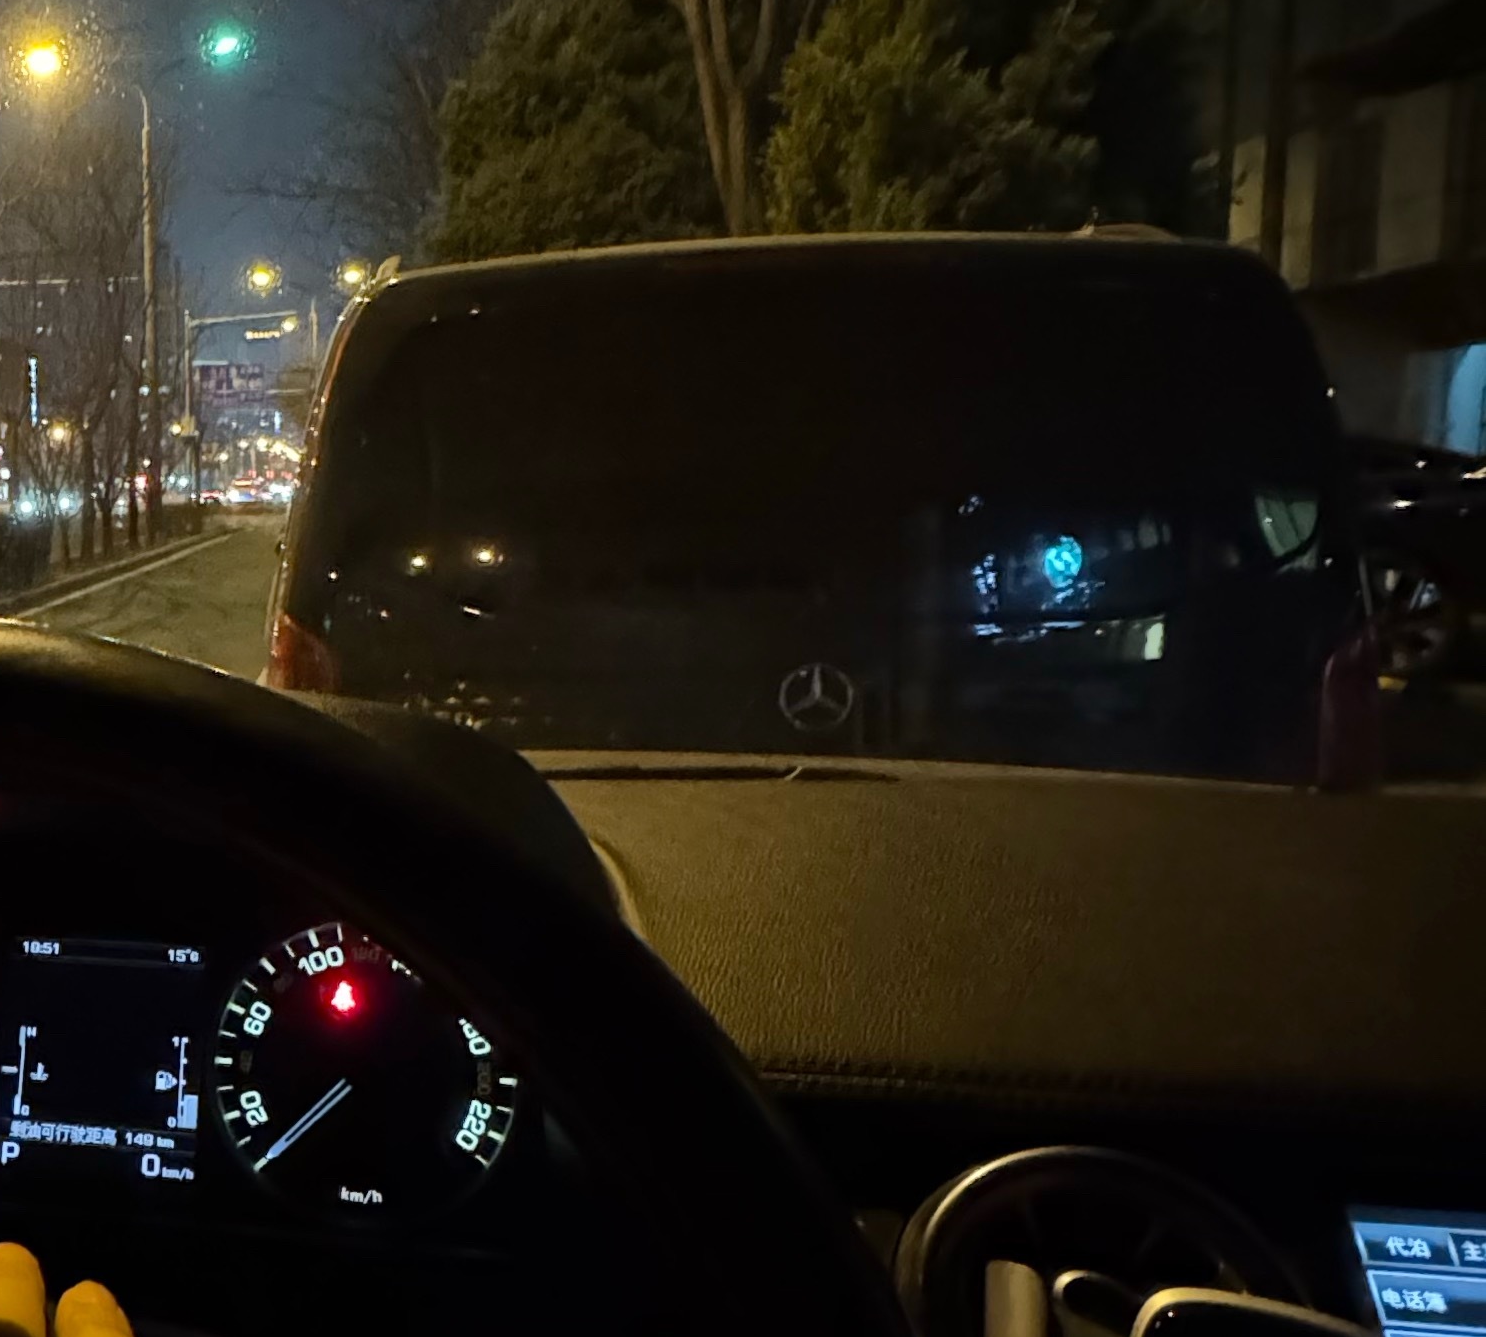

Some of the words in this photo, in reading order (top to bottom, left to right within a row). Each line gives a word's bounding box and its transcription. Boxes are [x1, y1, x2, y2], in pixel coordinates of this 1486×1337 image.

[22, 940, 60, 956] 10:51
[298, 946, 344, 976] 100
[243, 1001, 272, 1036] 60
[240, 1090, 269, 1127] 20
[454, 1099, 492, 1151] 220
[1, 1141, 21, 1166] P
[156, 1136, 174, 1149] km
[141, 1153, 160, 1177] 0
[340, 1186, 383, 1204] km/h
[1462, 1240, 1486, 1263] 主
